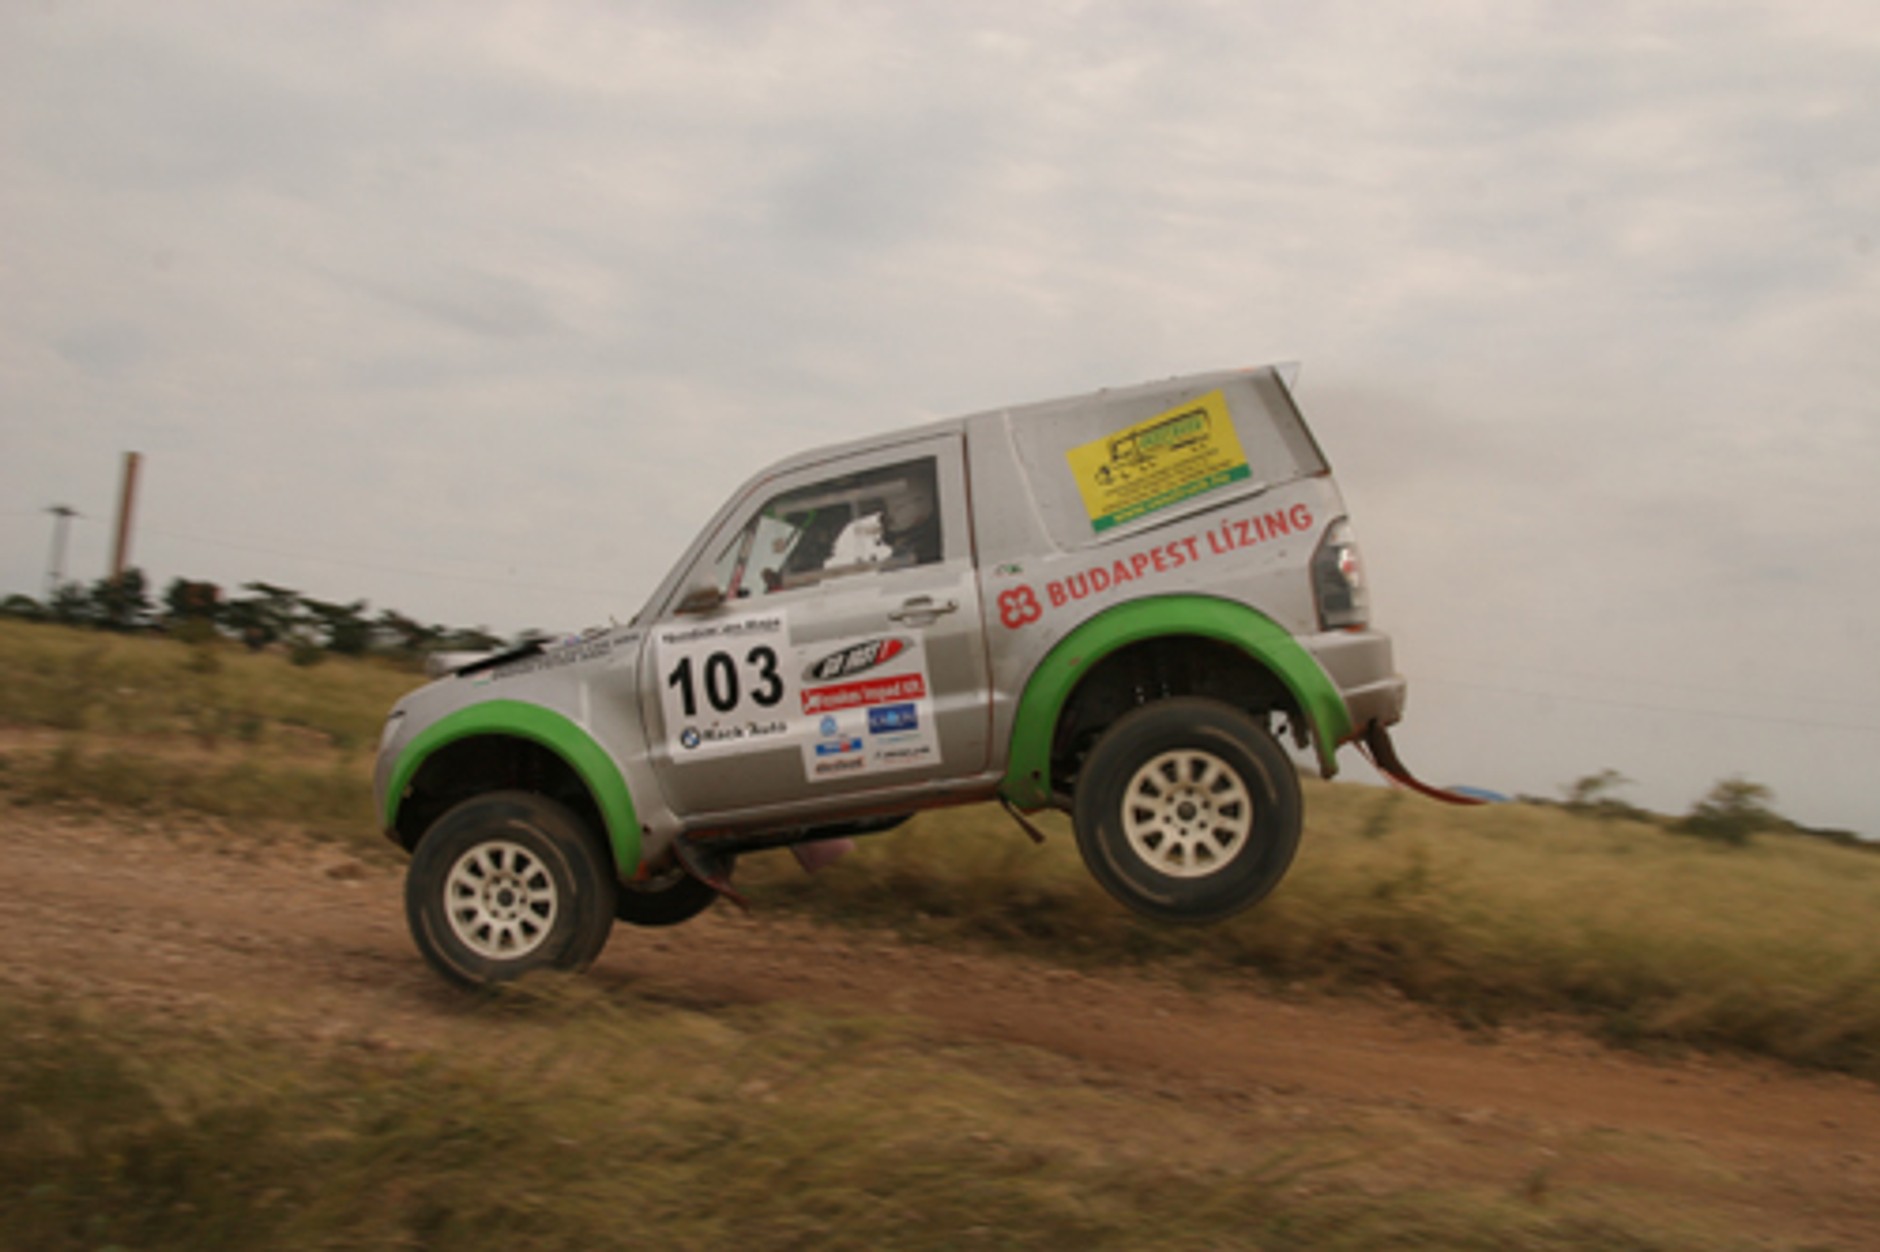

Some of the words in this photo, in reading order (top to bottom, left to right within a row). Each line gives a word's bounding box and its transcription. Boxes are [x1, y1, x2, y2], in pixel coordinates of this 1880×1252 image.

[1046, 535, 1200, 607] BUDAPEST
[1206, 503, 1314, 556] LÍZING
[669, 645, 784, 716] 103
